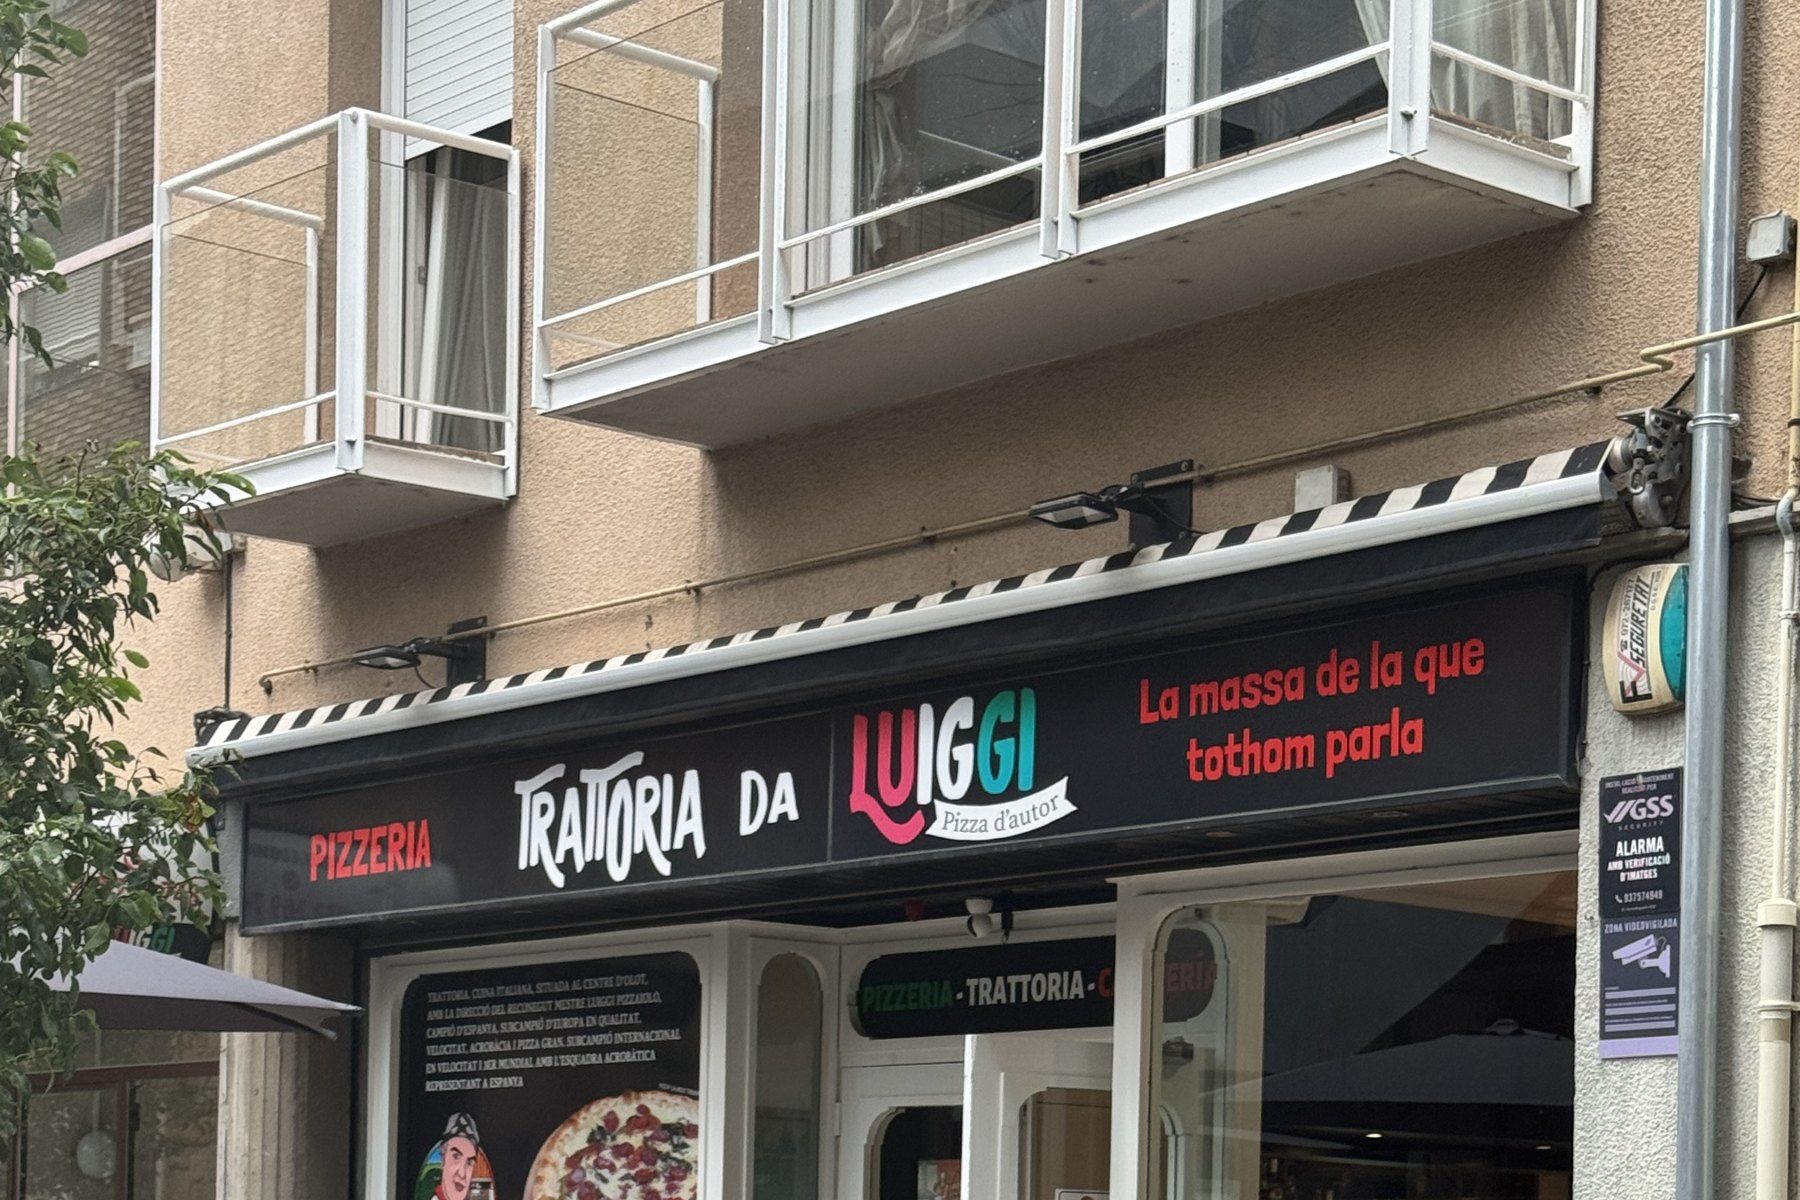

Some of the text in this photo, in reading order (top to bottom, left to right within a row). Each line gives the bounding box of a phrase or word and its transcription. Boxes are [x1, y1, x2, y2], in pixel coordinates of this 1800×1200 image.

[1629, 575, 1650, 668] SEGURETAT
[1139, 637, 1485, 724] La massa de la que
[1187, 707, 1424, 782] tothom parla
[309, 687, 1036, 888] PIZZERIA TRATTORIA DA LUIGGI
[942, 795, 1059, 833] Pizza d'autor
[1616, 836, 1664, 857] ALARMA
[1607, 853, 1671, 871] AMB VERIFICACIÓ
[1620, 868, 1658, 882] D'IMATGES
[1604, 918, 1678, 934] ZONA VIDEOVIGILADA
[862, 980, 952, 1013] PIZZERIA
[966, 970, 1085, 1007] TRATTORIA
[426, 1063, 437, 1074] EN
[437, 1060, 478, 1073] VELOCITAT
[489, 1076, 524, 1089] ESPANYA
